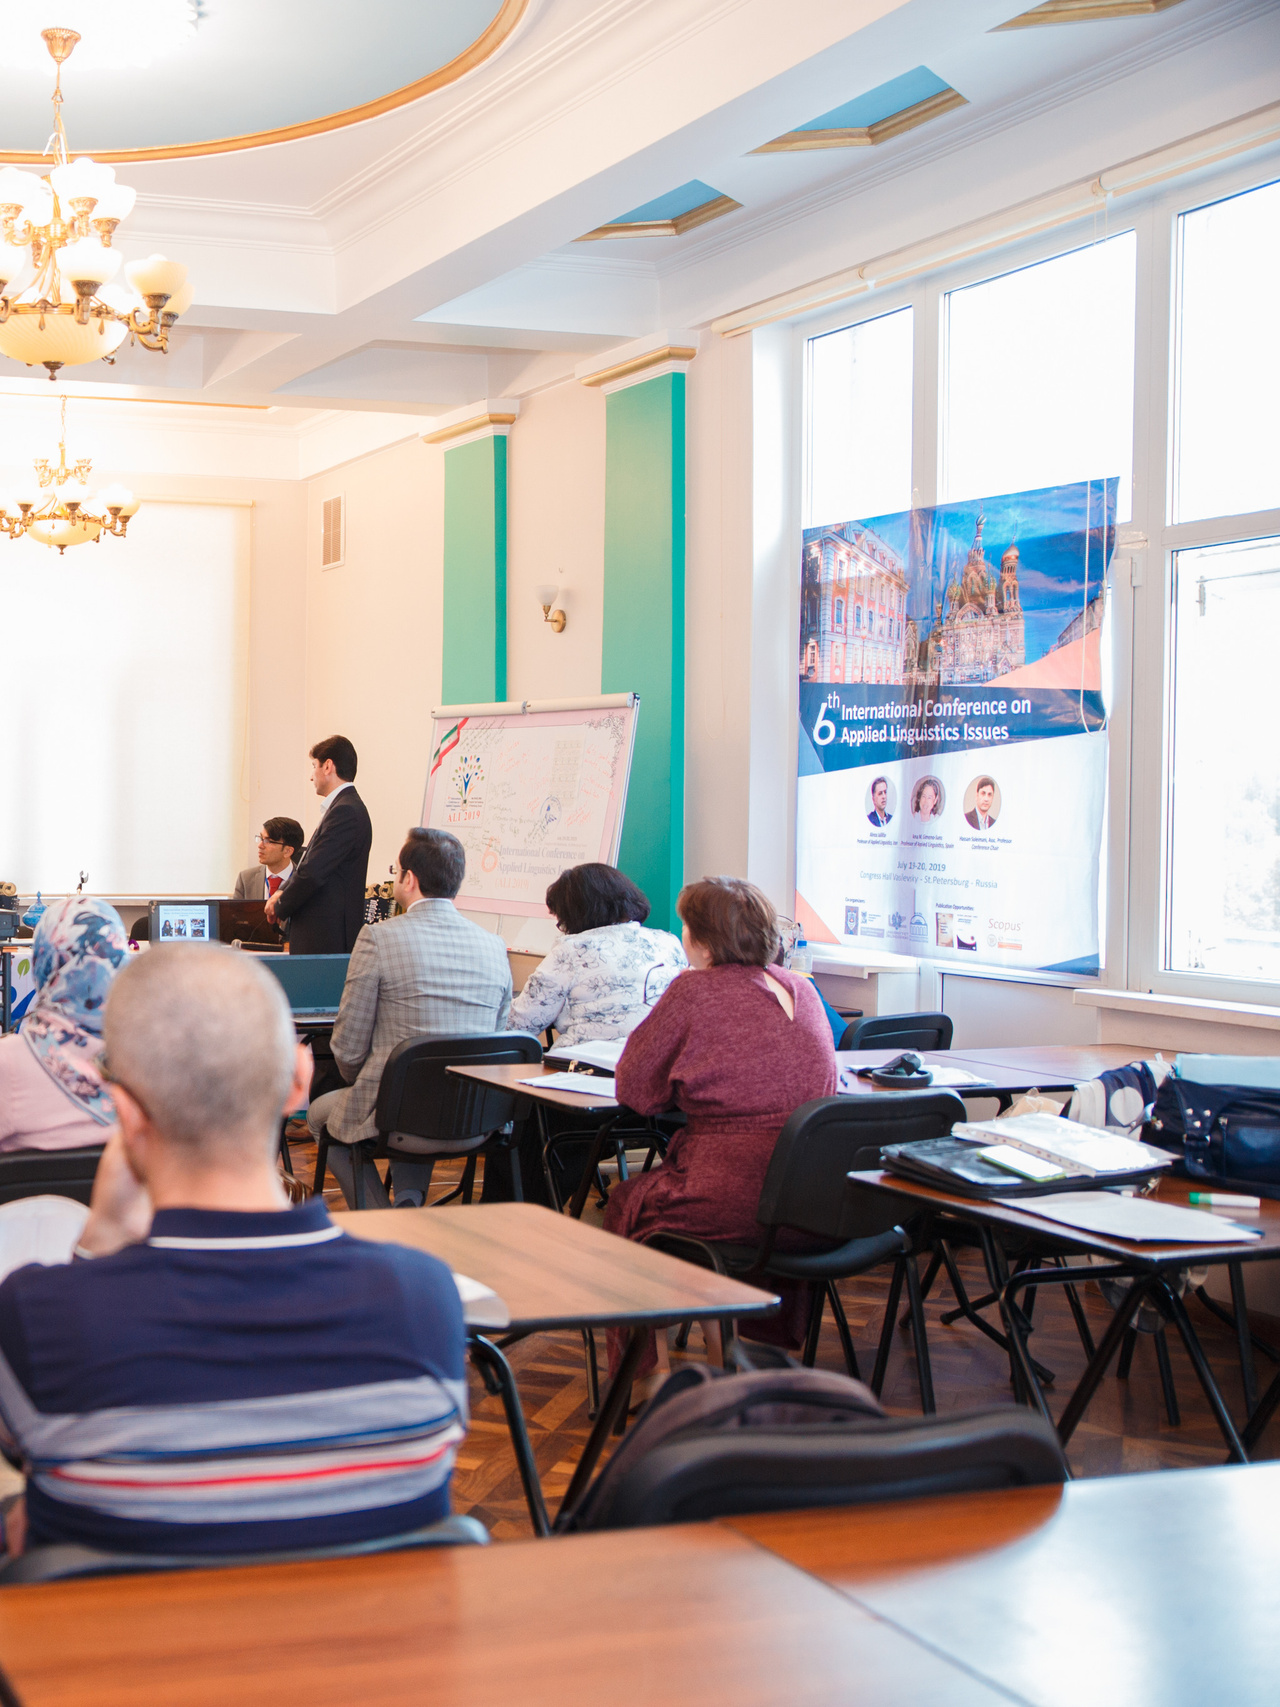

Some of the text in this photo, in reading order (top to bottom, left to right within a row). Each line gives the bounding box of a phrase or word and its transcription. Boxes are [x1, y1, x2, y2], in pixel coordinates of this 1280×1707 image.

[841, 698, 922, 721] International
[924, 697, 1007, 718] Conference
[1010, 699, 1031, 715] on
[840, 722, 1010, 747] Applied Linguistics Issues
[463, 810, 481, 821] 2019
[500, 845, 540, 858] International
[541, 846, 577, 860] Conference
[577, 851, 586, 860] on
[499, 860, 523, 875] Applied
[523, 862, 557, 876] Linguistics
[896, 860, 908, 870] July
[928, 862, 946, 872] 2019
[860, 870, 882, 880] Congress
[882, 872, 892, 880] Hall
[975, 879, 998, 889] Russia
[988, 918, 1022, 931] Scopus
